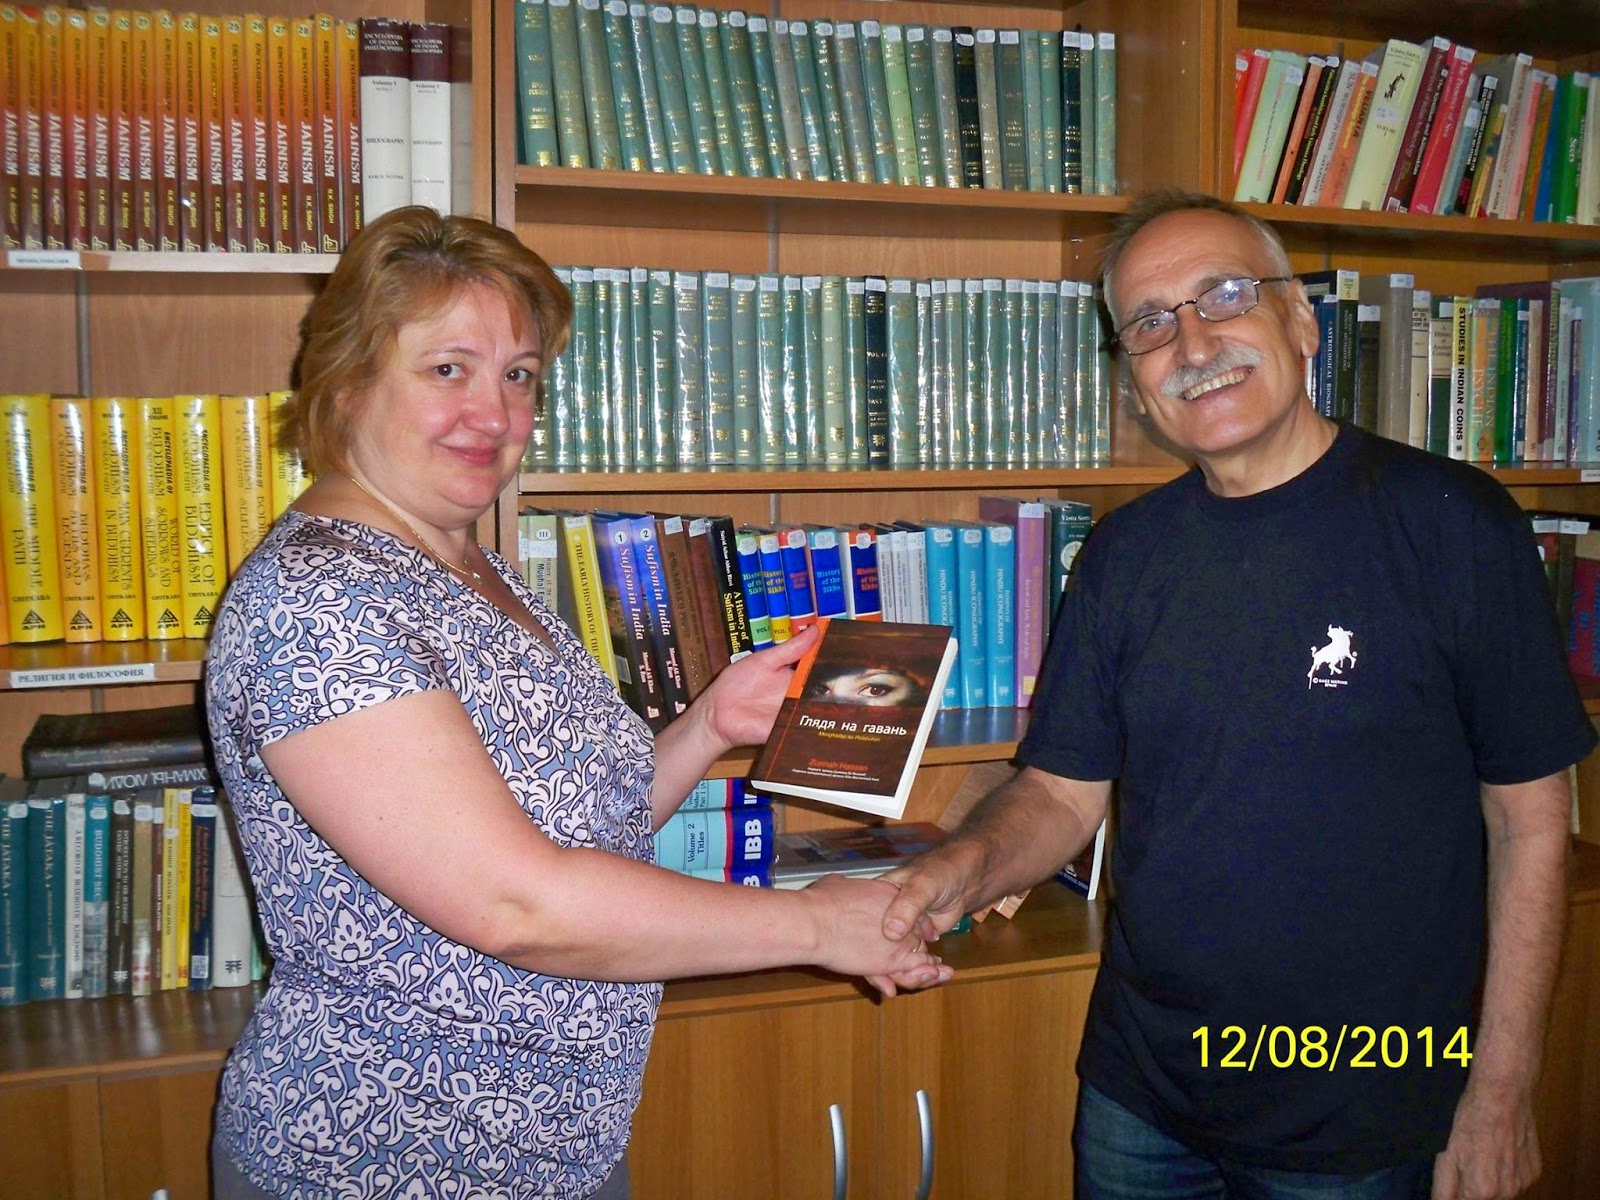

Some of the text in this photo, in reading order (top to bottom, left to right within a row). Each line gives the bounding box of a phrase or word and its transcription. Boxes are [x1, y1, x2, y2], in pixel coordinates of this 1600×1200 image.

[207, 26, 218, 34] 24
[229, 22, 240, 30] 25
[252, 22, 263, 30] 26
[275, 25, 286, 33] 27
[299, 26, 309, 34] 28
[320, 20, 331, 28] 29
[346, 28, 357, 36] 30
[1345, 72, 1356, 88] SUN
[1353, 90, 1373, 137] VEDANTA
[6, 110, 18, 176] JAINISM
[28, 111, 40, 176] JAINISM
[49, 112, 61, 177] JAINISM
[74, 114, 86, 179] JAINISM
[96, 113, 108, 178] JAINISM
[119, 116, 130, 181] JAINISM
[140, 115, 152, 180] JAINISM
[164, 114, 175, 178] JAINISM
[185, 118, 198, 180] JAINISM
[210, 122, 222, 185] JAINISM
[232, 119, 243, 182] JAINISM
[255, 118, 266, 181] JAINISM
[277, 121, 288, 184] JAINISM
[302, 122, 313, 184] JAINISM
[323, 115, 335, 177] JAINISM
[350, 122, 360, 184] JAINISM
[1296, 159, 1309, 181] Theology
[1458, 353, 1465, 365] IN
[1485, 330, 1498, 427] THE INDIAN
[1457, 369, 1465, 404] INDIAN
[1471, 368, 1483, 427] PSYCHE
[1456, 408, 1464, 441] COINS
[153, 427, 164, 500] BUDDHISM:
[164, 432, 173, 493] ENCYCLOPAEDIA OF
[202, 430, 210, 491] ENCYCLOPAEDIA OF
[13, 530, 25, 564] PATH
[28, 505, 42, 587] THE MIDDLE
[62, 517, 72, 579] LEGENDS
[81, 513, 91, 581] BUDDHA'S
[106, 510, 118, 583] IN BUDDHISM
[119, 501, 132, 590] MAIN CURRENTS
[145, 517, 157, 578] SUFFERINGS
[158, 507, 171, 588] SORROWS AND
[171, 518, 180, 555] WORLD
[186, 506, 200, 583] BUDDHISM
[575, 543, 584, 561] THE
[642, 530, 649, 538] 2
[73, 558, 81, 585] AND
[203, 565, 215, 586] OF
[577, 562, 588, 586] EARLY
[619, 548, 644, 640] Sufism in India
[645, 545, 671, 636] Sufism in India
[816, 570, 840, 578] History
[823, 585, 840, 593] Sikhs
[582, 588, 593, 623] HISTORY
[589, 624, 597, 635] OF
[724, 593, 740, 653] Sufism in India
[734, 600, 746, 630] History
[741, 633, 749, 641] of
[590, 638, 599, 652] THE
[18, 669, 144, 683] РЕЛИГИЯ И ФИЛОСОФИЯ
[800, 715, 907, 735] Глядя на гавань
[102, 773, 147, 790] ЛЮДИ
[46, 809, 54, 830] THE
[744, 819, 762, 860] IBB
[94, 830, 102, 878] BUDDHIST
[688, 833, 696, 862] Volume
